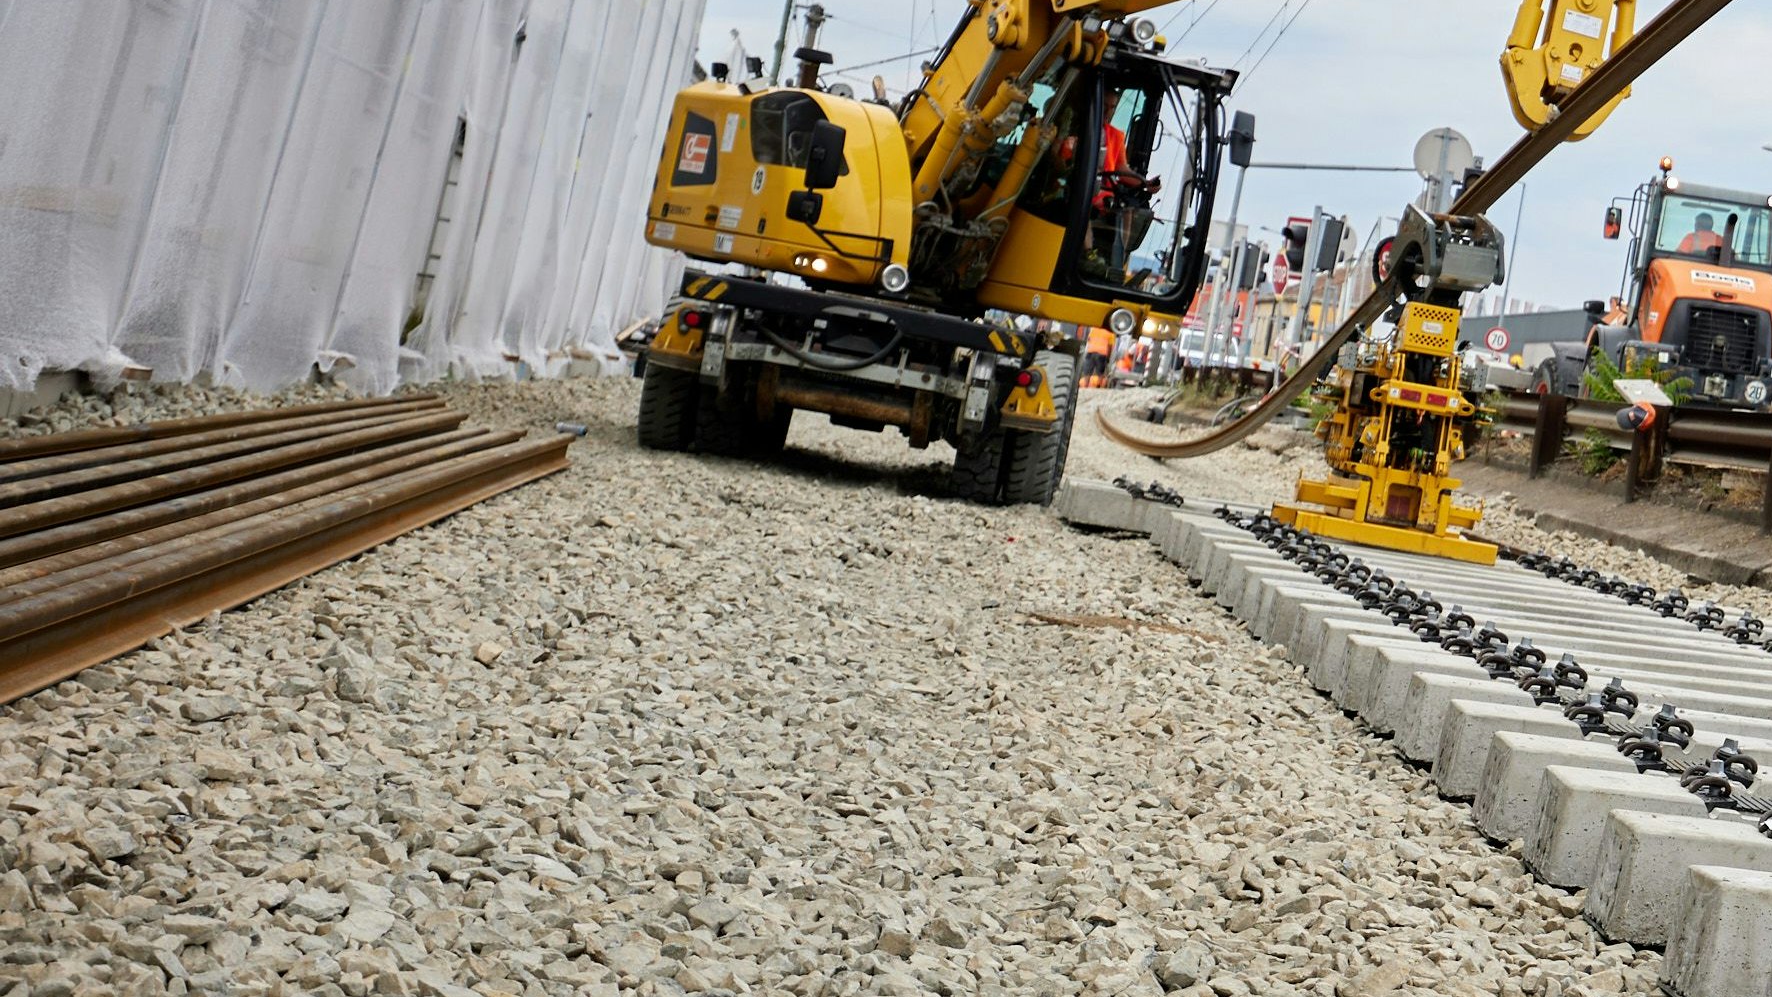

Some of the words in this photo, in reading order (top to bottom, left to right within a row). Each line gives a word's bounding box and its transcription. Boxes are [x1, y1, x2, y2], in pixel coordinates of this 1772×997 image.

[753, 166, 764, 191] 19
[1272, 265, 1287, 284] STOP
[1491, 333, 1504, 347] 70
